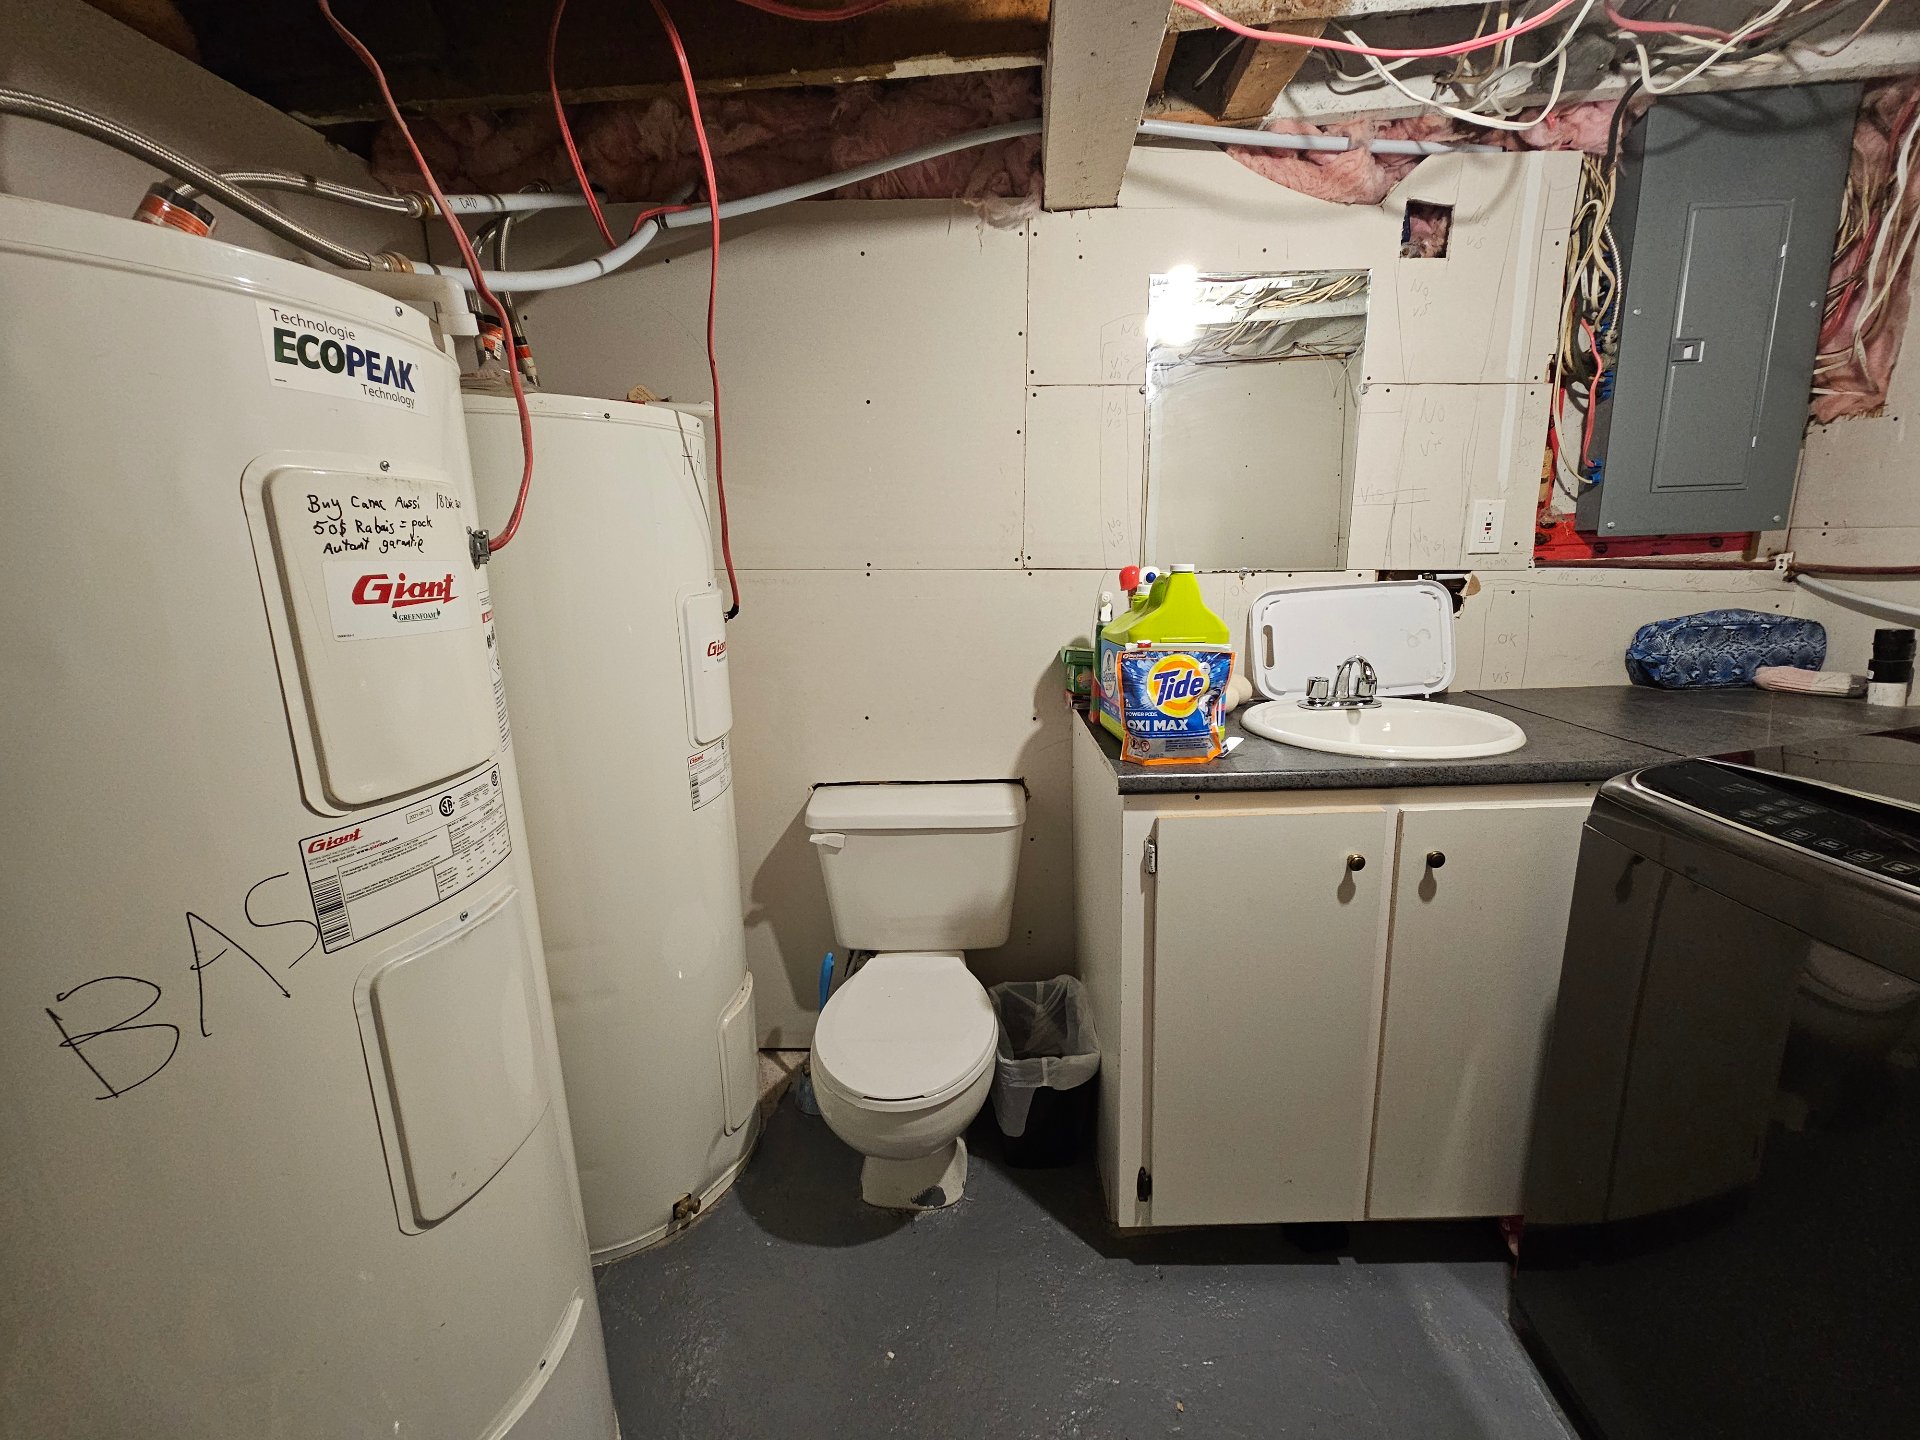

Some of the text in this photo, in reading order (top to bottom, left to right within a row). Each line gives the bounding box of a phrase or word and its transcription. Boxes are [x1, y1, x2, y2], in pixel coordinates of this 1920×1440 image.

[269, 307, 356, 341] Technologie
[361, 383, 415, 409] Technology
[1418, 397, 1446, 424] No
[306, 494, 343, 521] Buy
[395, 495, 421, 510] Aussi
[313, 518, 347, 538] 50$
[355, 516, 395, 535] Rabais
[351, 572, 460, 608] Giant
[398, 611, 437, 623] GREENFOAM
[1152, 669, 1205, 707] Tide
[1126, 719, 1189, 731] OXI MAX
[308, 827, 365, 855] Giant
[45, 871, 320, 1100] BAS
